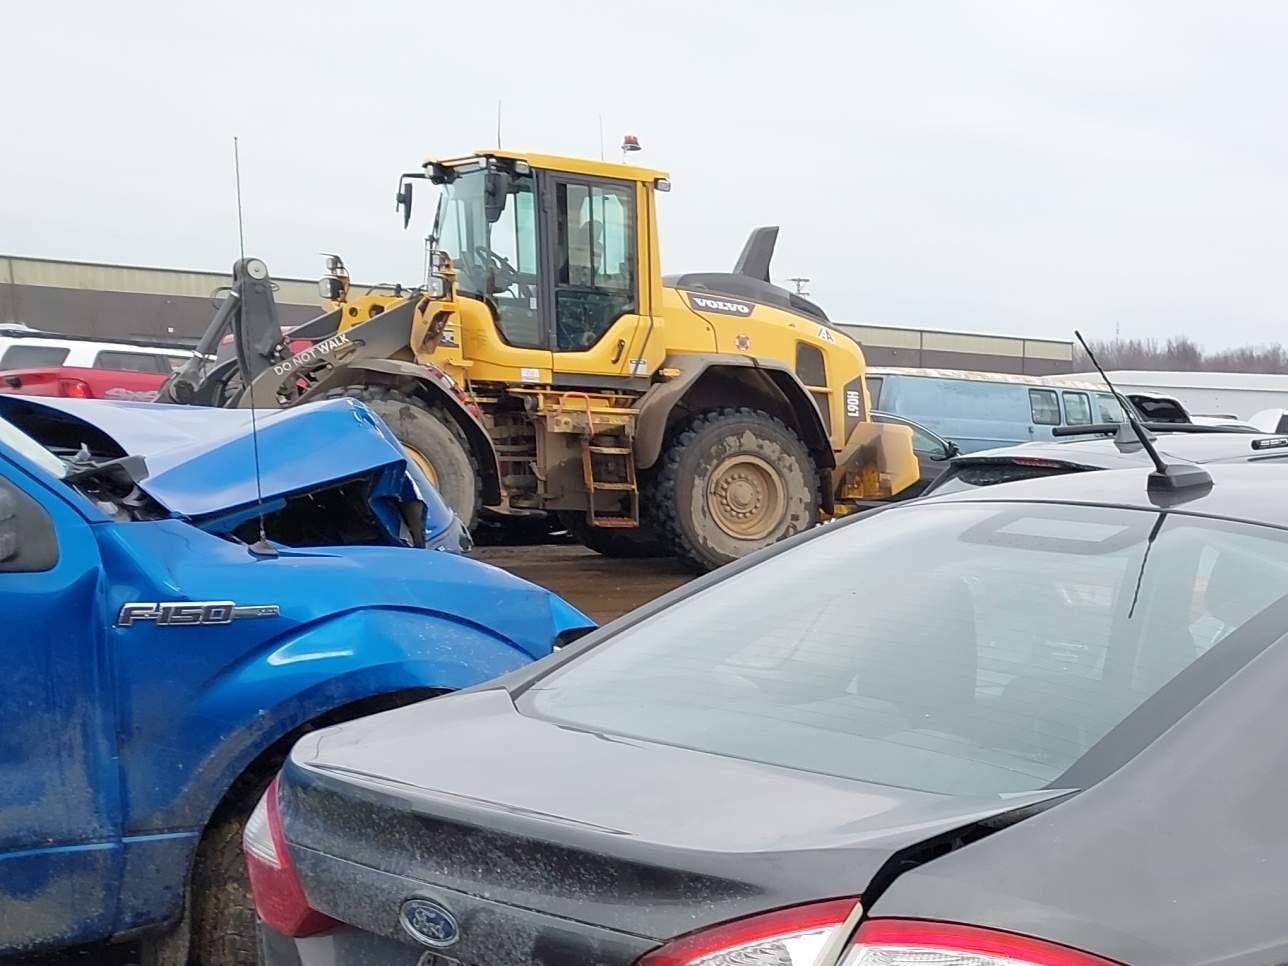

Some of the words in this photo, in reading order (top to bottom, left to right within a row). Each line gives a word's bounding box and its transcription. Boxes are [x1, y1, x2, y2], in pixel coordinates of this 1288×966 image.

[692, 297, 750, 314] VOLVO
[273, 361, 292, 376] DO
[292, 349, 317, 367] NOT
[318, 334, 350, 354] WALK
[846, 391, 860, 417] L90H
[118, 602, 236, 626] F-150
